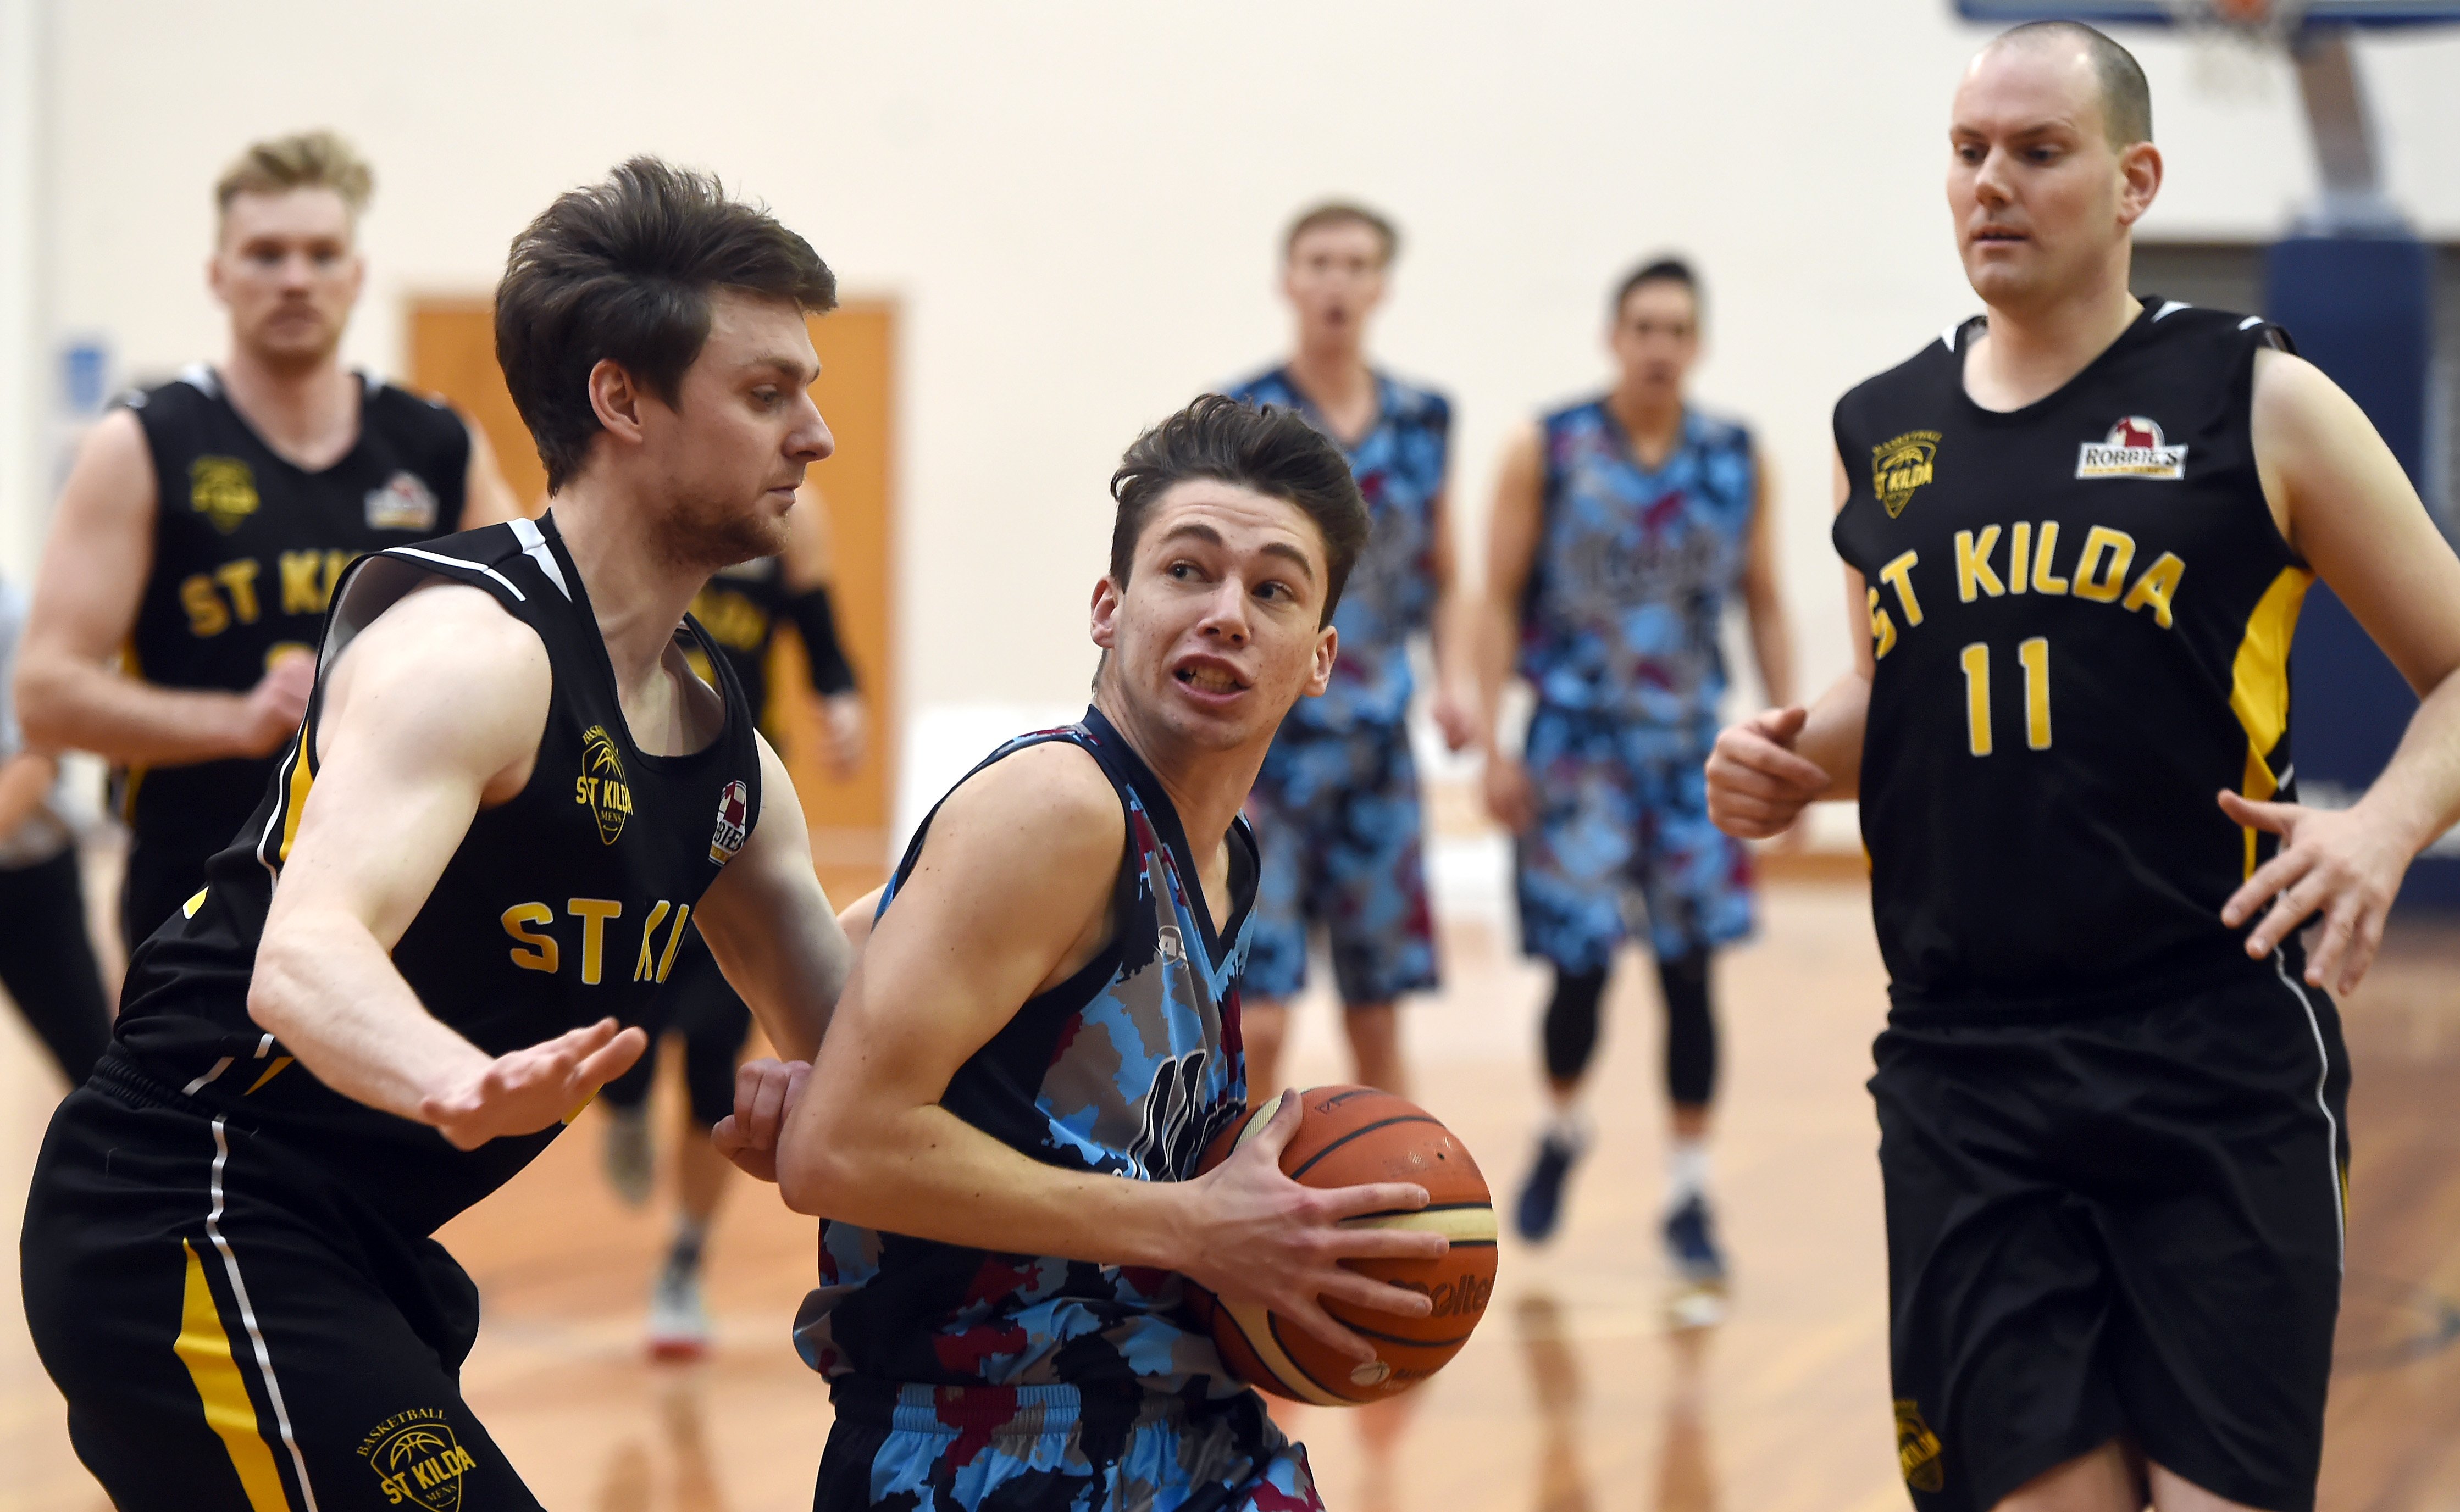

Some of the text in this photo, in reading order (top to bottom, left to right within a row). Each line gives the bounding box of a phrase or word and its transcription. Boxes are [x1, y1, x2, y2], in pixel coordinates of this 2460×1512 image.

[179, 559, 260, 637] ST
[1954, 520, 2186, 630] KILDA
[1960, 636, 2052, 757] 11
[575, 776, 634, 816] ST KILDA
[501, 898, 690, 986] ST KI
[356, 1408, 446, 1457] BASKETBALL
[380, 1446, 477, 1504] ST KILDA
[425, 1483, 458, 1501] MENS
